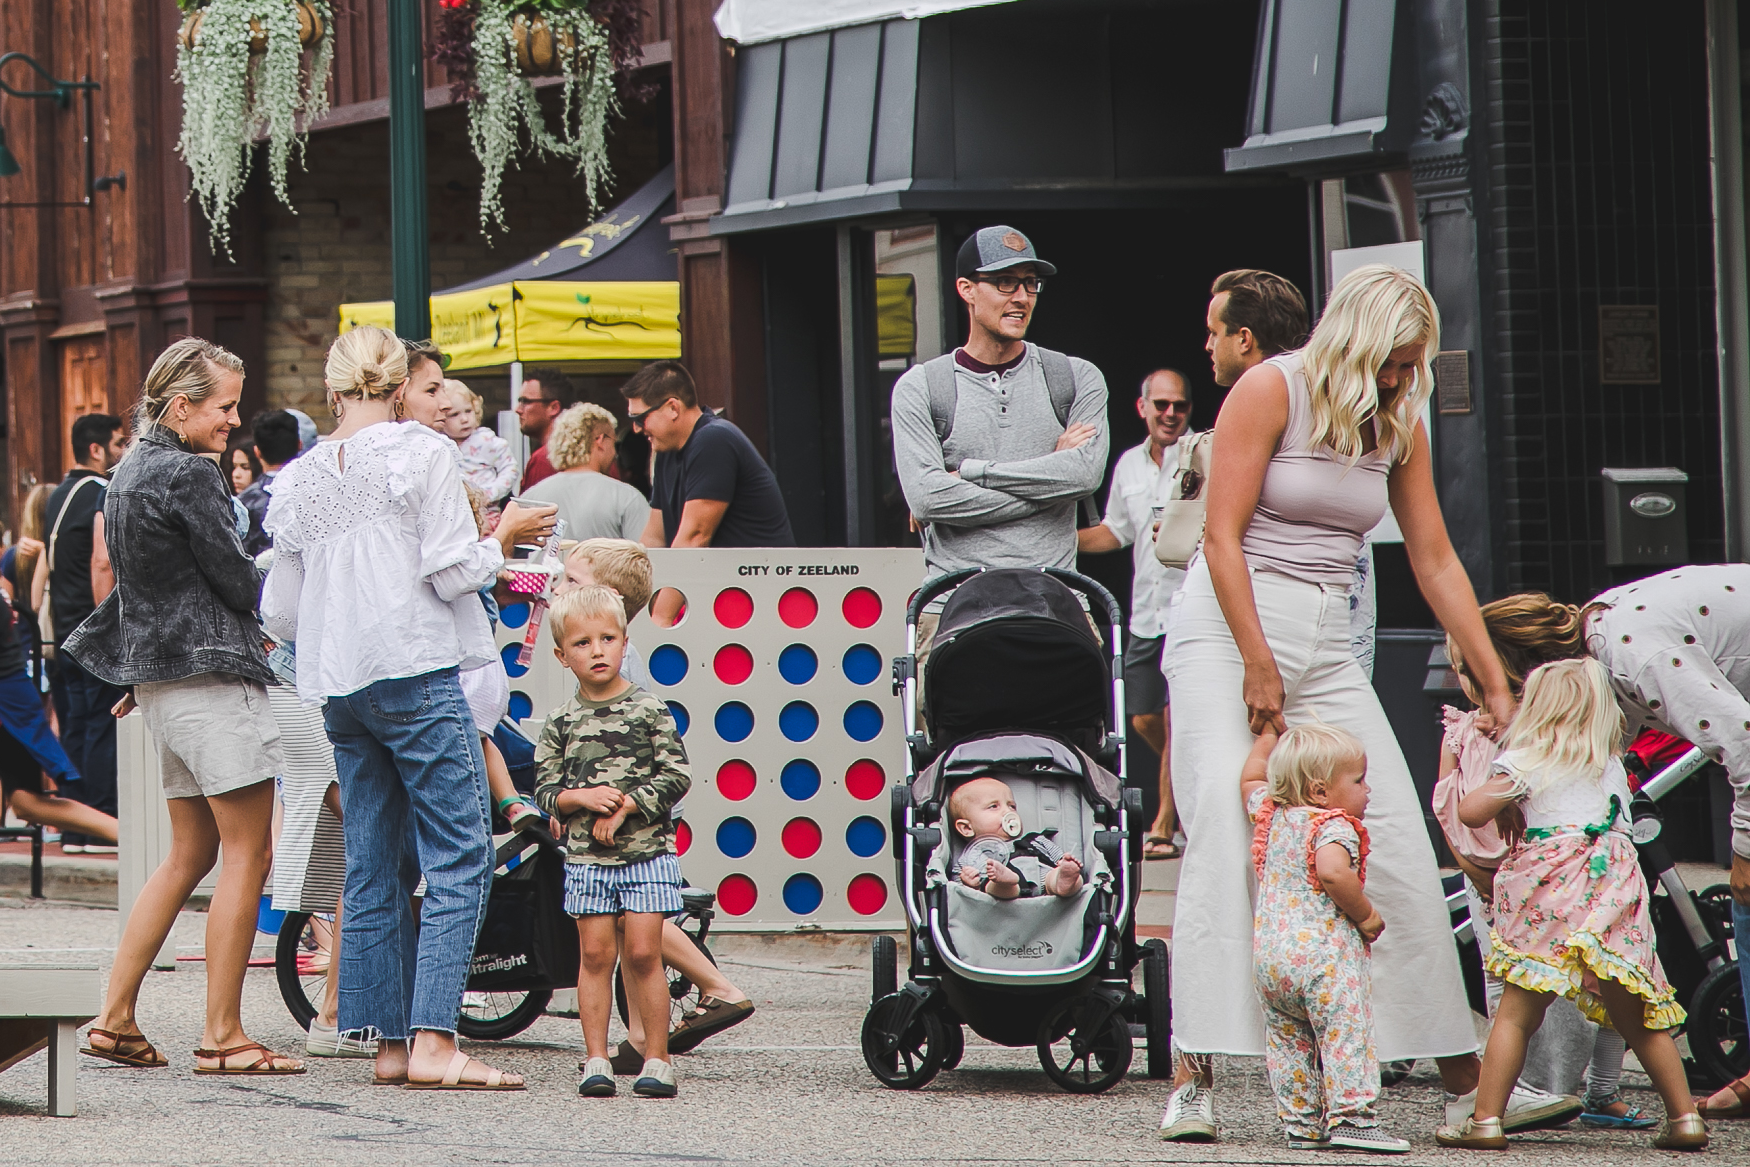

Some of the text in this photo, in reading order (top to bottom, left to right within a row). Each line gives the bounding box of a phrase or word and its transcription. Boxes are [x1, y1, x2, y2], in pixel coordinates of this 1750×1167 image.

[738, 565, 860, 576] CITY OF ZEELAND
